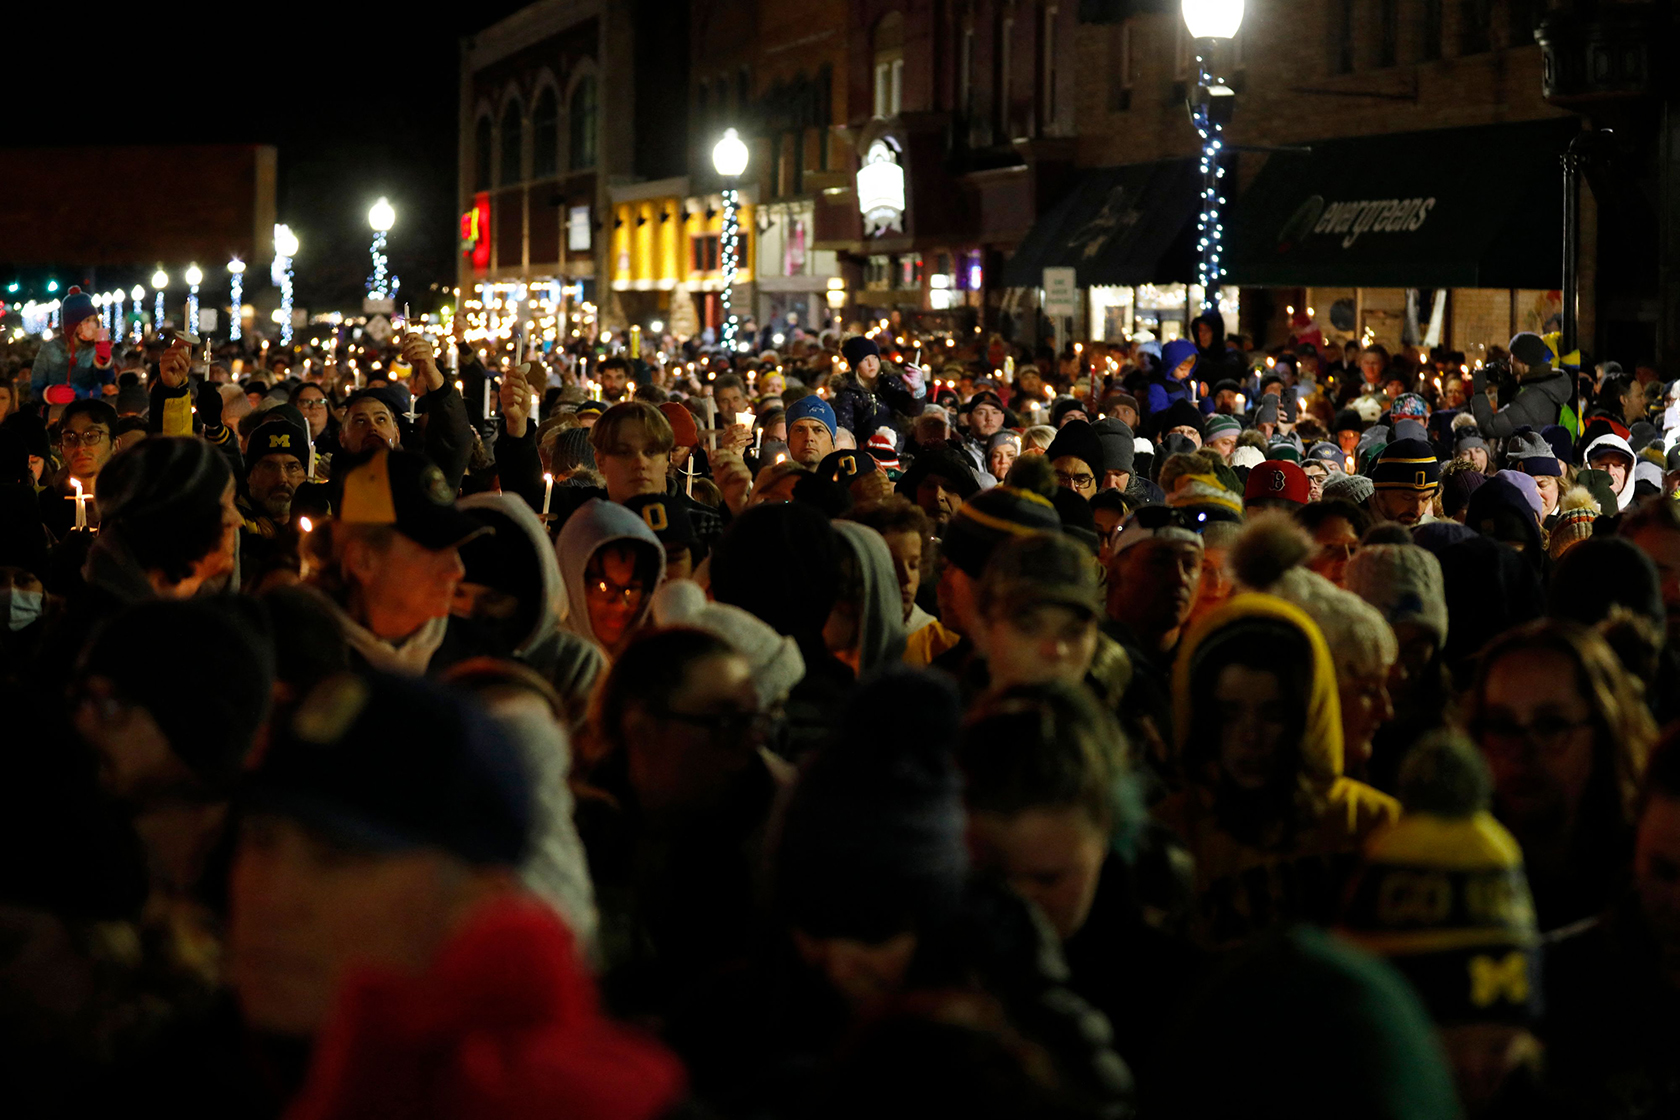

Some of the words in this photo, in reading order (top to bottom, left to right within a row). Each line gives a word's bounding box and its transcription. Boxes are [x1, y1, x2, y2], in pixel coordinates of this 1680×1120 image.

[1314, 197, 1436, 248] evergreens
[269, 434, 291, 448] M
[1268, 470, 1286, 491] B
[642, 502, 669, 531] O
